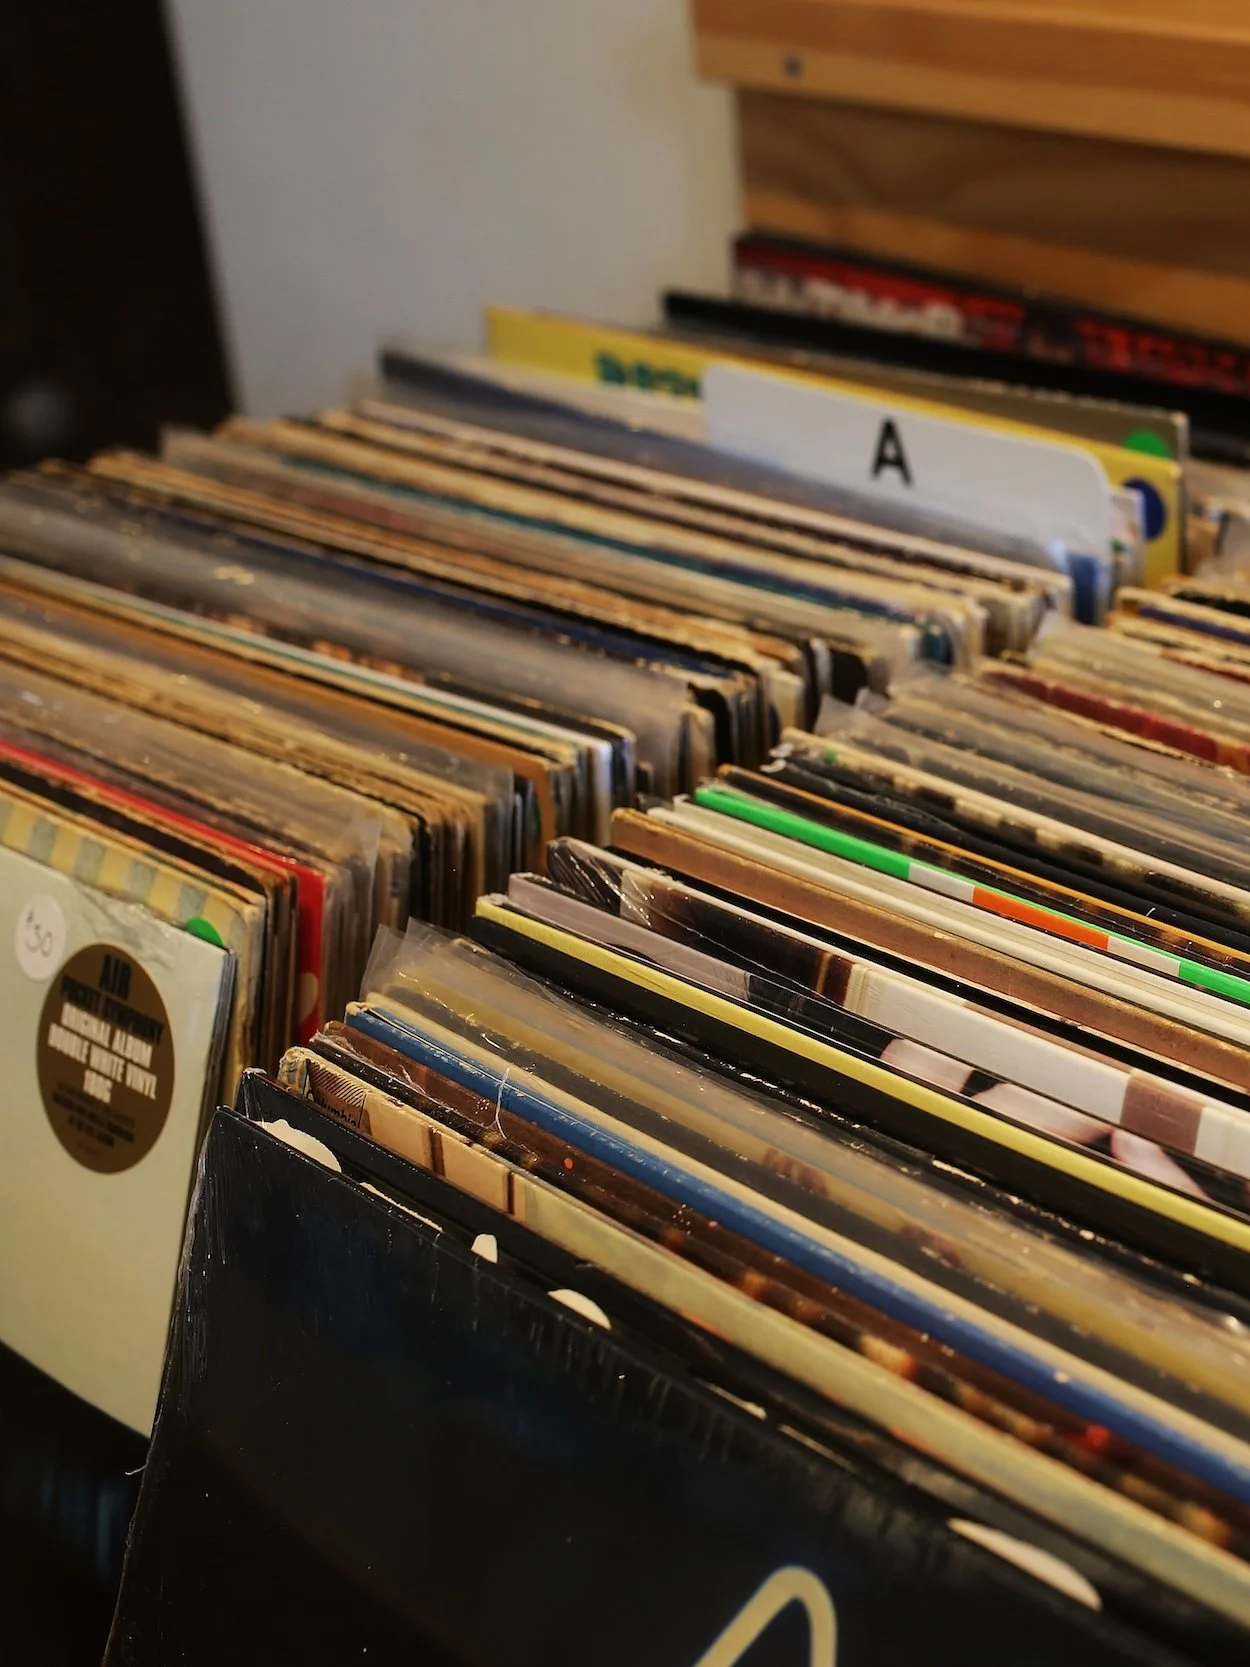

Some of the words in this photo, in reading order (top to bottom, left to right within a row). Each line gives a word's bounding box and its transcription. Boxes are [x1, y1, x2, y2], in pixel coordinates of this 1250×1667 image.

[871, 416, 914, 487] A
[99, 953, 132, 1000] AIR
[48, 1022, 90, 1064] DOUBLE
[90, 1043, 125, 1083] WHITE
[126, 1061, 157, 1100] VINYL
[61, 1001, 111, 1048] ORIGINAL
[111, 1028, 153, 1068] ALBUM
